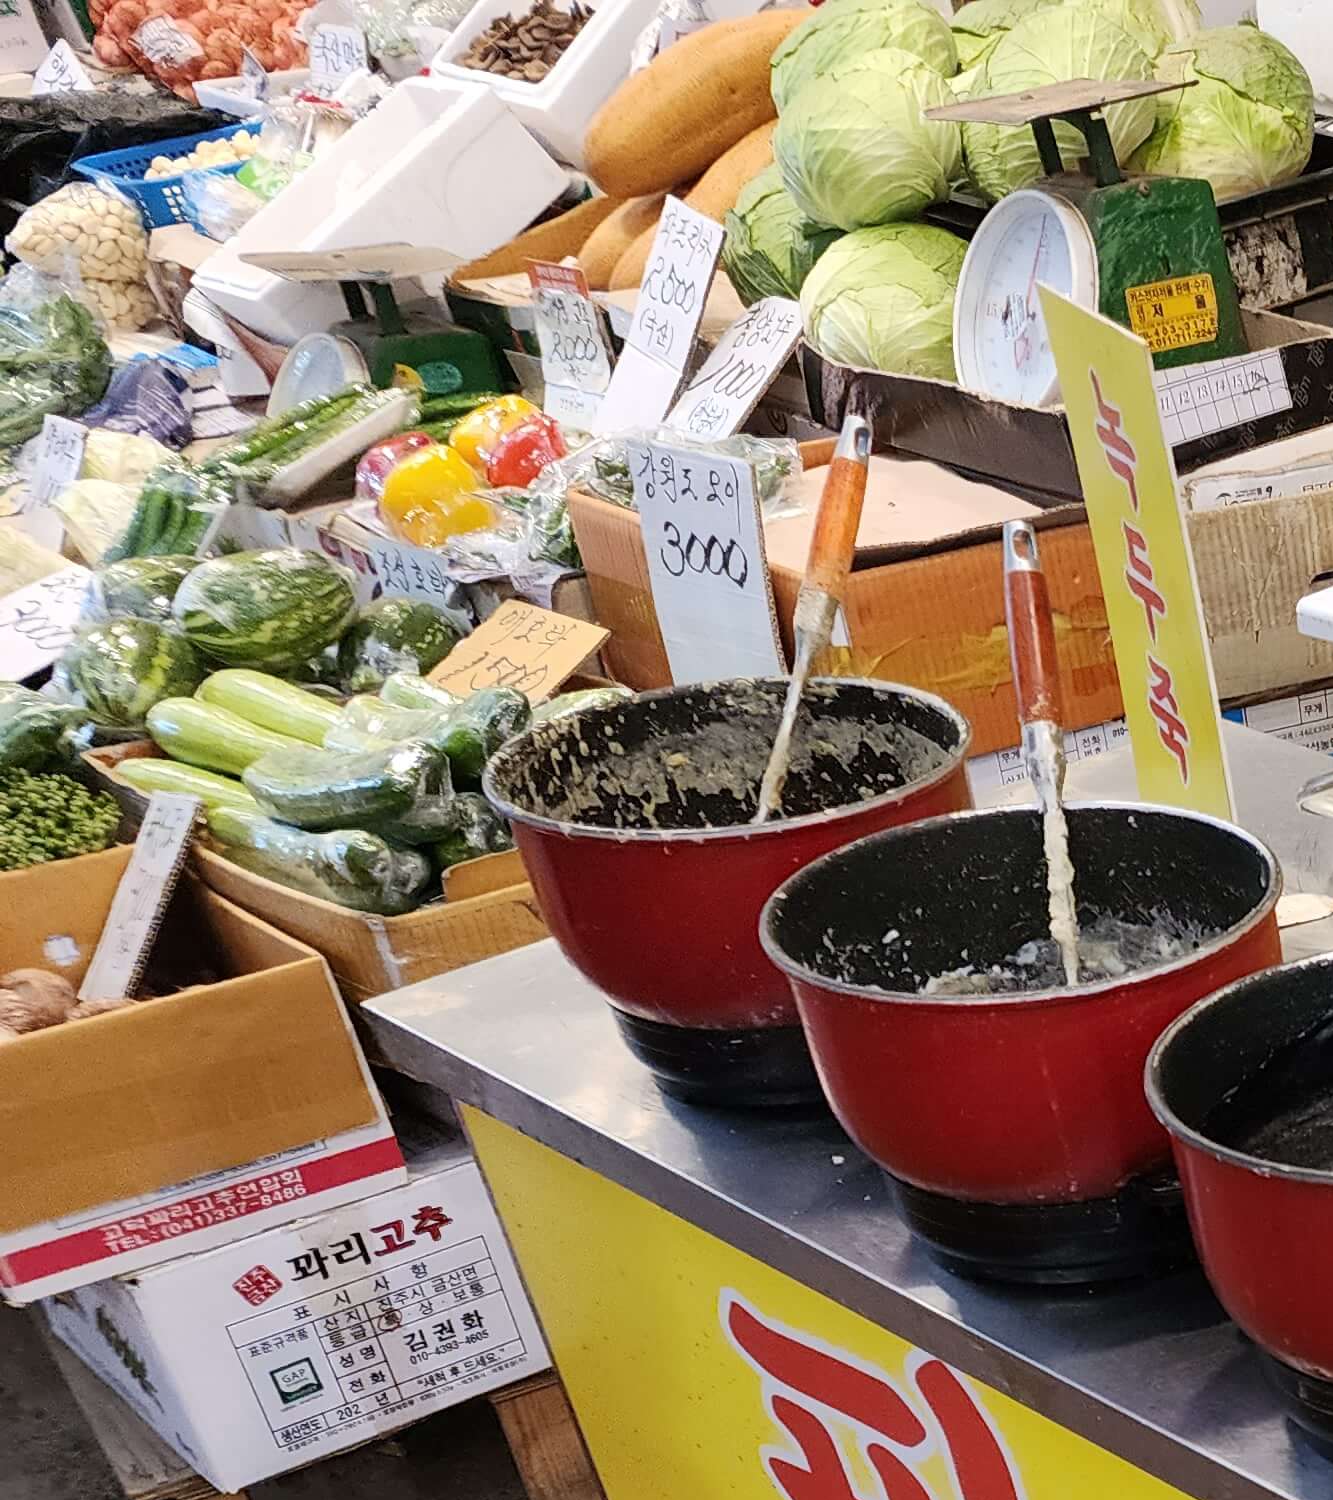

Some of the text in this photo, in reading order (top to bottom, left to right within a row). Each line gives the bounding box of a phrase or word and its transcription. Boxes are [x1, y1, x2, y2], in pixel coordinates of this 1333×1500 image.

[1178, 390, 1190, 405] 12
[1197, 384, 1209, 400] 13
[1214, 377, 1226, 394] 14
[1232, 372, 1244, 390] 15
[638, 448, 741, 533] 강원도 오이
[661, 521, 748, 588] 3000
[491, 608, 578, 662] 애호박
[285, 1205, 453, 1282] 꽈리고추
[376, 1285, 426, 1312] 진주시
[431, 1266, 478, 1294] 금산면
[418, 1299, 434, 1316] 상
[281, 1368, 306, 1384] GAP
[335, 1404, 362, 1422] 202
[375, 1392, 390, 1408] 년
